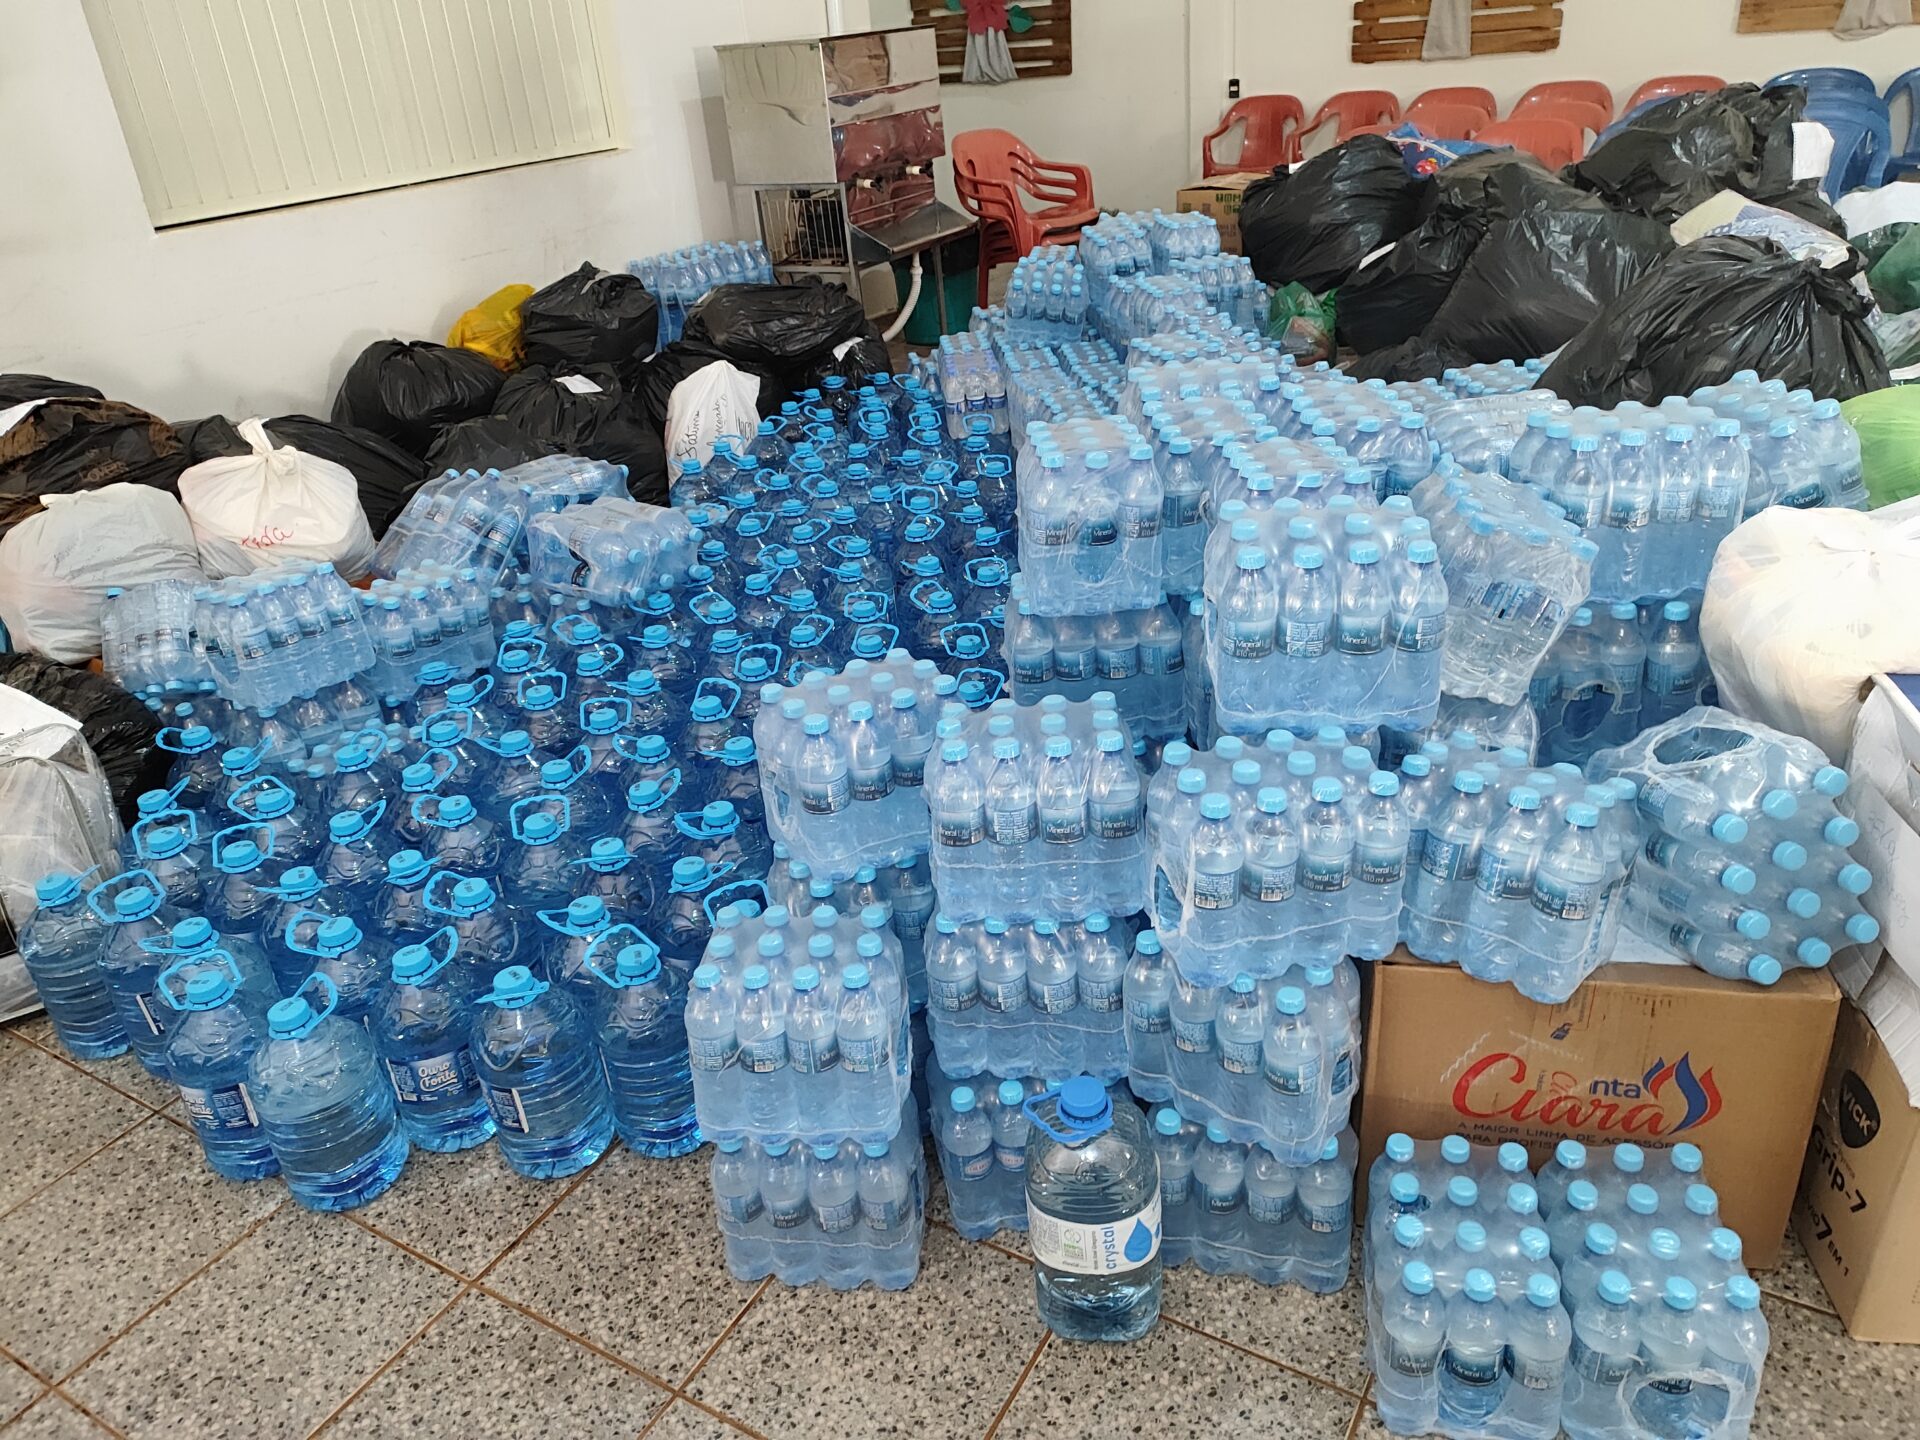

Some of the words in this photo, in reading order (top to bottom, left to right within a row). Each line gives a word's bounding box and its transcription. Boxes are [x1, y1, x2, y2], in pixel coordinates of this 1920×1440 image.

[1235, 638, 1260, 649] Mineral
[1342, 634, 1367, 645] Mineral
[1047, 825, 1071, 834] Mineral
[1102, 819, 1126, 828] Mineral
[1363, 863, 1389, 874] Mineral
[418, 1062, 451, 1077] Ouro
[420, 1070, 457, 1090] Fonte
[1588, 1078, 1642, 1099] nta
[1842, 1083, 1872, 1137] VICK
[1473, 1123, 1520, 1135] MAIOR
[1526, 1129, 1568, 1139] LINHA
[1576, 1133, 1596, 1144] DE
[1811, 1123, 1867, 1214] Grip-7
[1816, 1213, 1833, 1241] 7
[1100, 1225, 1119, 1270] crystal
[1453, 1363, 1480, 1378] Mineral
